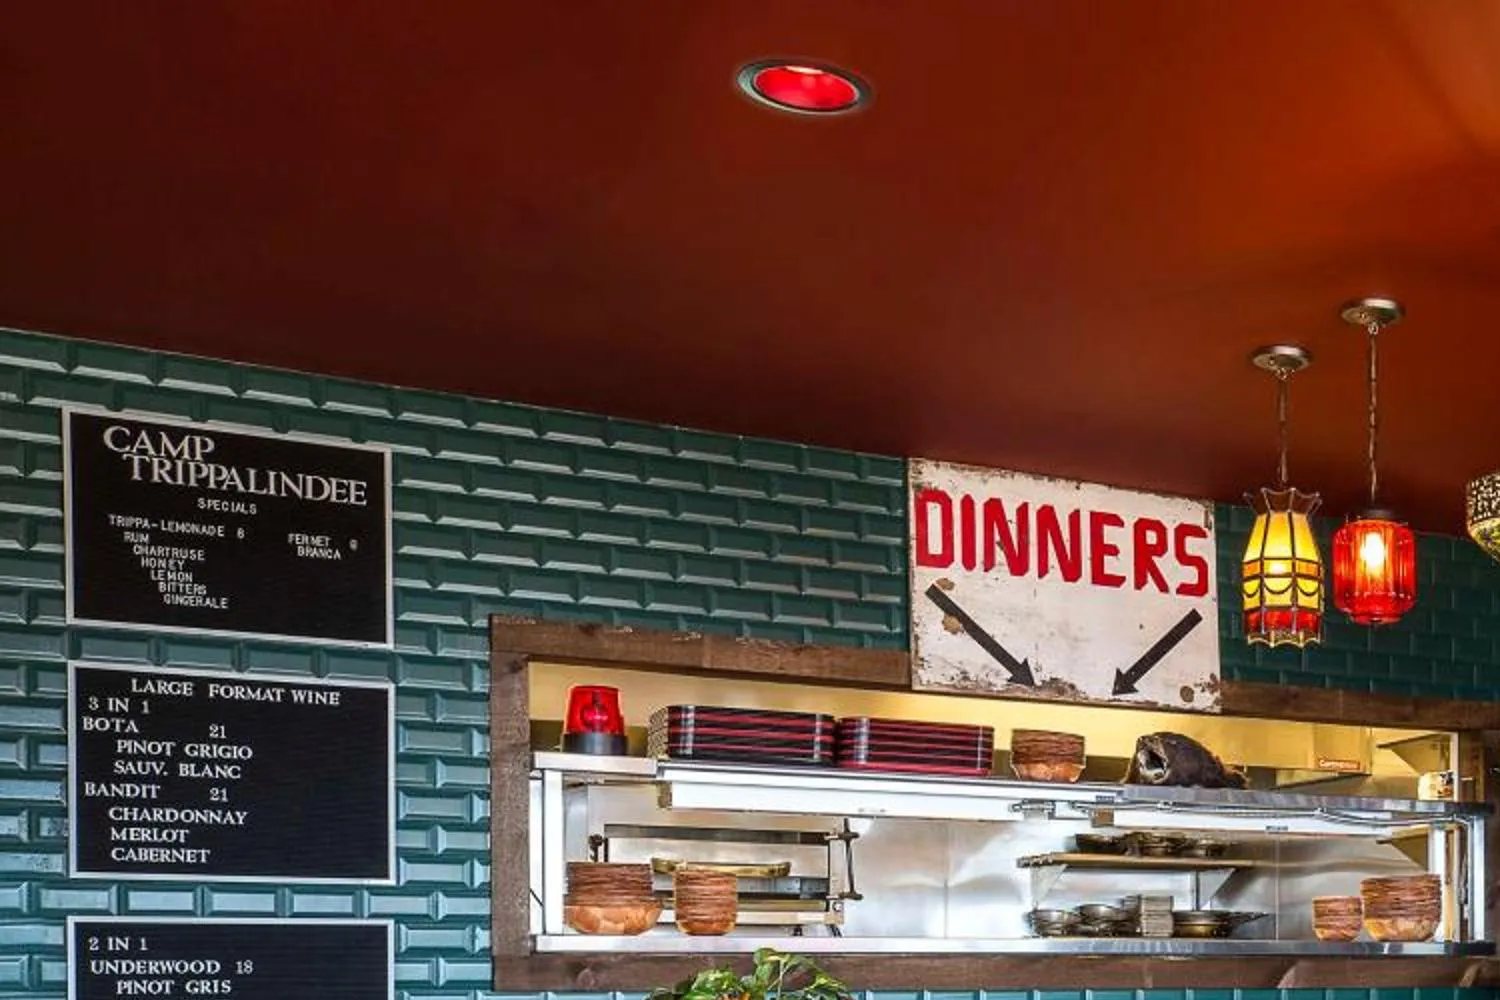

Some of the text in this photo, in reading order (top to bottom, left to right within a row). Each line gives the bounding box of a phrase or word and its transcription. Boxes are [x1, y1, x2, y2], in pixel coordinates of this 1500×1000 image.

[103, 426, 214, 460] CAMP
[123, 453, 367, 506] TRIPPALINDEE
[198, 498, 257, 514] SPECIALS
[124, 532, 149, 543] RUM
[288, 533, 330, 547] FERNET
[914, 487, 1209, 597] DINNERS
[134, 545, 205, 561] CHARTRUSE
[297, 547, 340, 559] BRANCA
[141, 558, 184, 570] HONEY
[151, 570, 192, 582] LEMON
[159, 582, 206, 594] BITTERS
[132, 679, 340, 705] LARGE FORMAT WINE
[89, 697, 150, 713] 3 IN 1
[83, 717, 226, 738] BOTA 21
[117, 740, 252, 759] PINOT GRIGIO
[114, 761, 241, 779] SAUV. BLANC
[84, 783, 229, 802] BANDIT 21
[109, 808, 249, 825] CHARDONNAY
[111, 828, 189, 842] MERLOT
[112, 848, 210, 863] CABERNET
[89, 938, 148, 951] 2 IN 1
[91, 960, 252, 974] UNDERWOOD 18
[116, 980, 231, 994] PINOT GRIS
